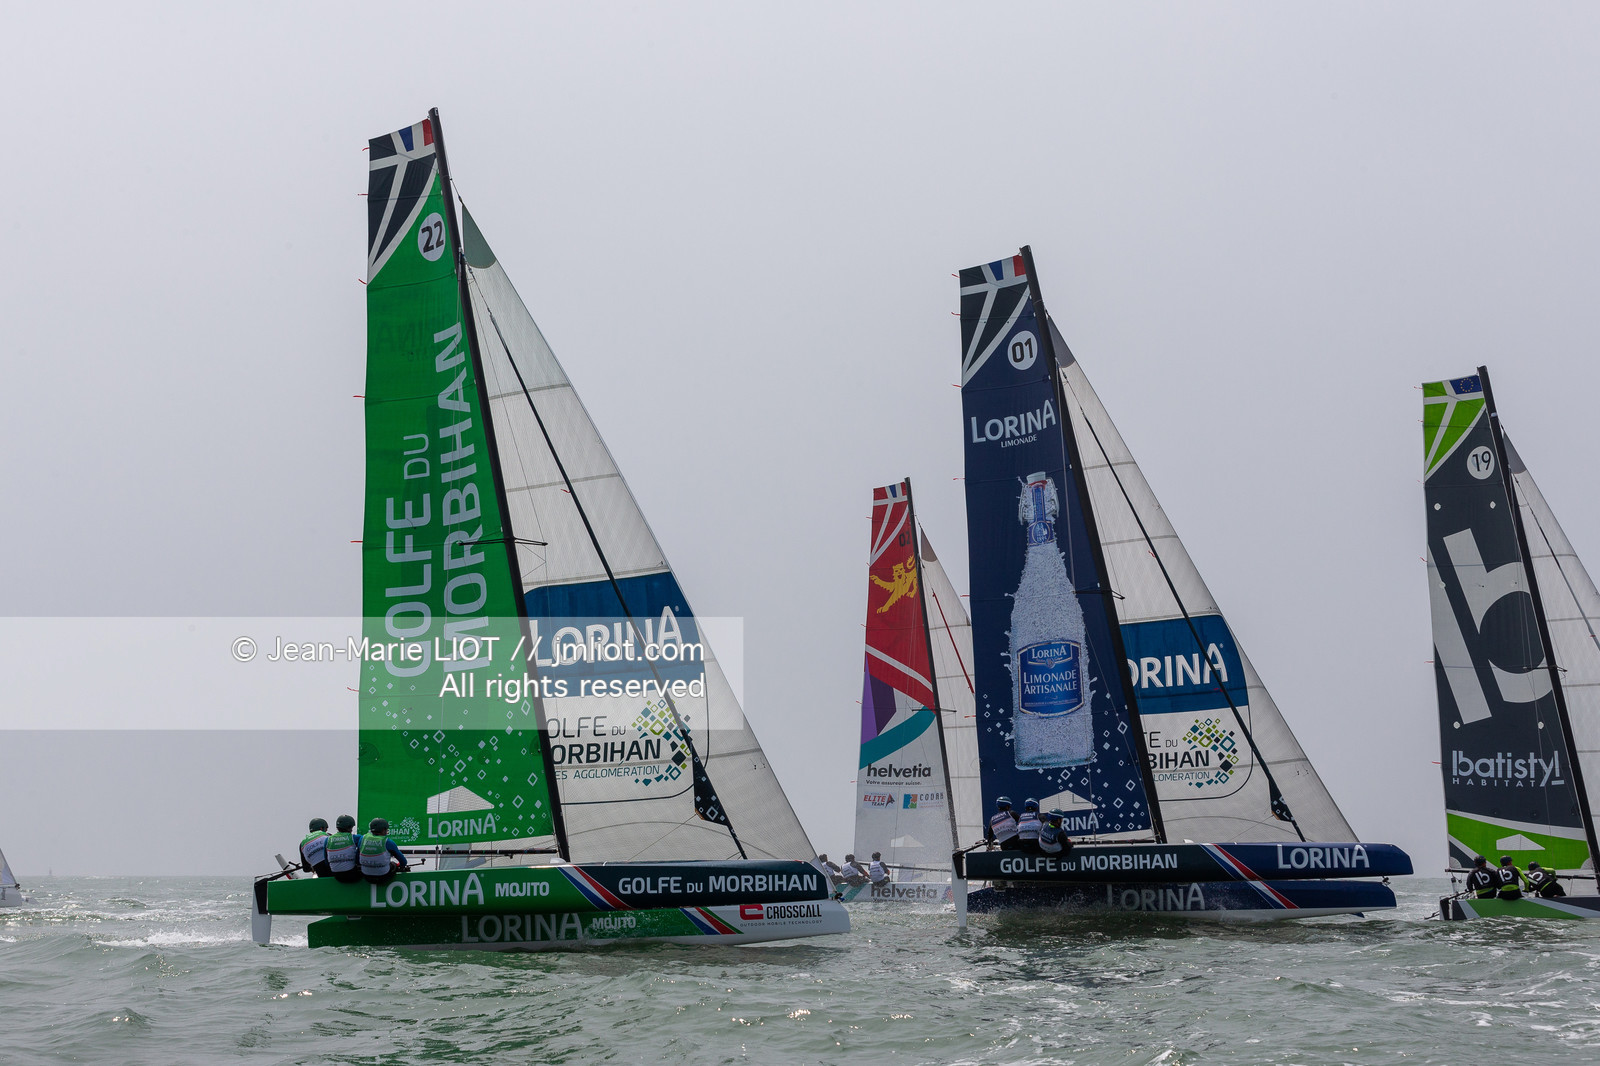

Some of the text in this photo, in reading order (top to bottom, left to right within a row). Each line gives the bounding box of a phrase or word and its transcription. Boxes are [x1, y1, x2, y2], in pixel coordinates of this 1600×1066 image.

[420, 221, 444, 253] 22
[1011, 337, 1034, 363] 01
[971, 399, 1057, 444] LORINA
[1000, 433, 1038, 448] LIMONADE
[1472, 450, 1492, 472] 19
[433, 321, 490, 674] MORBIHAN
[385, 433, 432, 678] GOLFE DU
[529, 605, 683, 667] LORINA
[1031, 645, 1068, 659] LORINA
[1023, 669, 1077, 684] LIMONADE
[1023, 680, 1078, 694] ARTISANALE
[546, 715, 608, 739] OLFE
[551, 738, 661, 765] ORBIHAN
[866, 763, 931, 778] helvetia
[1452, 777, 1536, 788] HABITAT
[863, 794, 887, 802] ELITE
[428, 812, 497, 839] LORINA
[1061, 811, 1099, 832] RINA
[1000, 853, 1178, 874] GOLFE DU MORBIHAN
[1276, 844, 1370, 869] LORINA
[370, 872, 550, 909] LORINA MOJITO
[618, 874, 817, 895] GOLFE DU MORBIHAN
[766, 903, 823, 920] CROSSCALL
[461, 912, 637, 943] LORINA MOJITO
